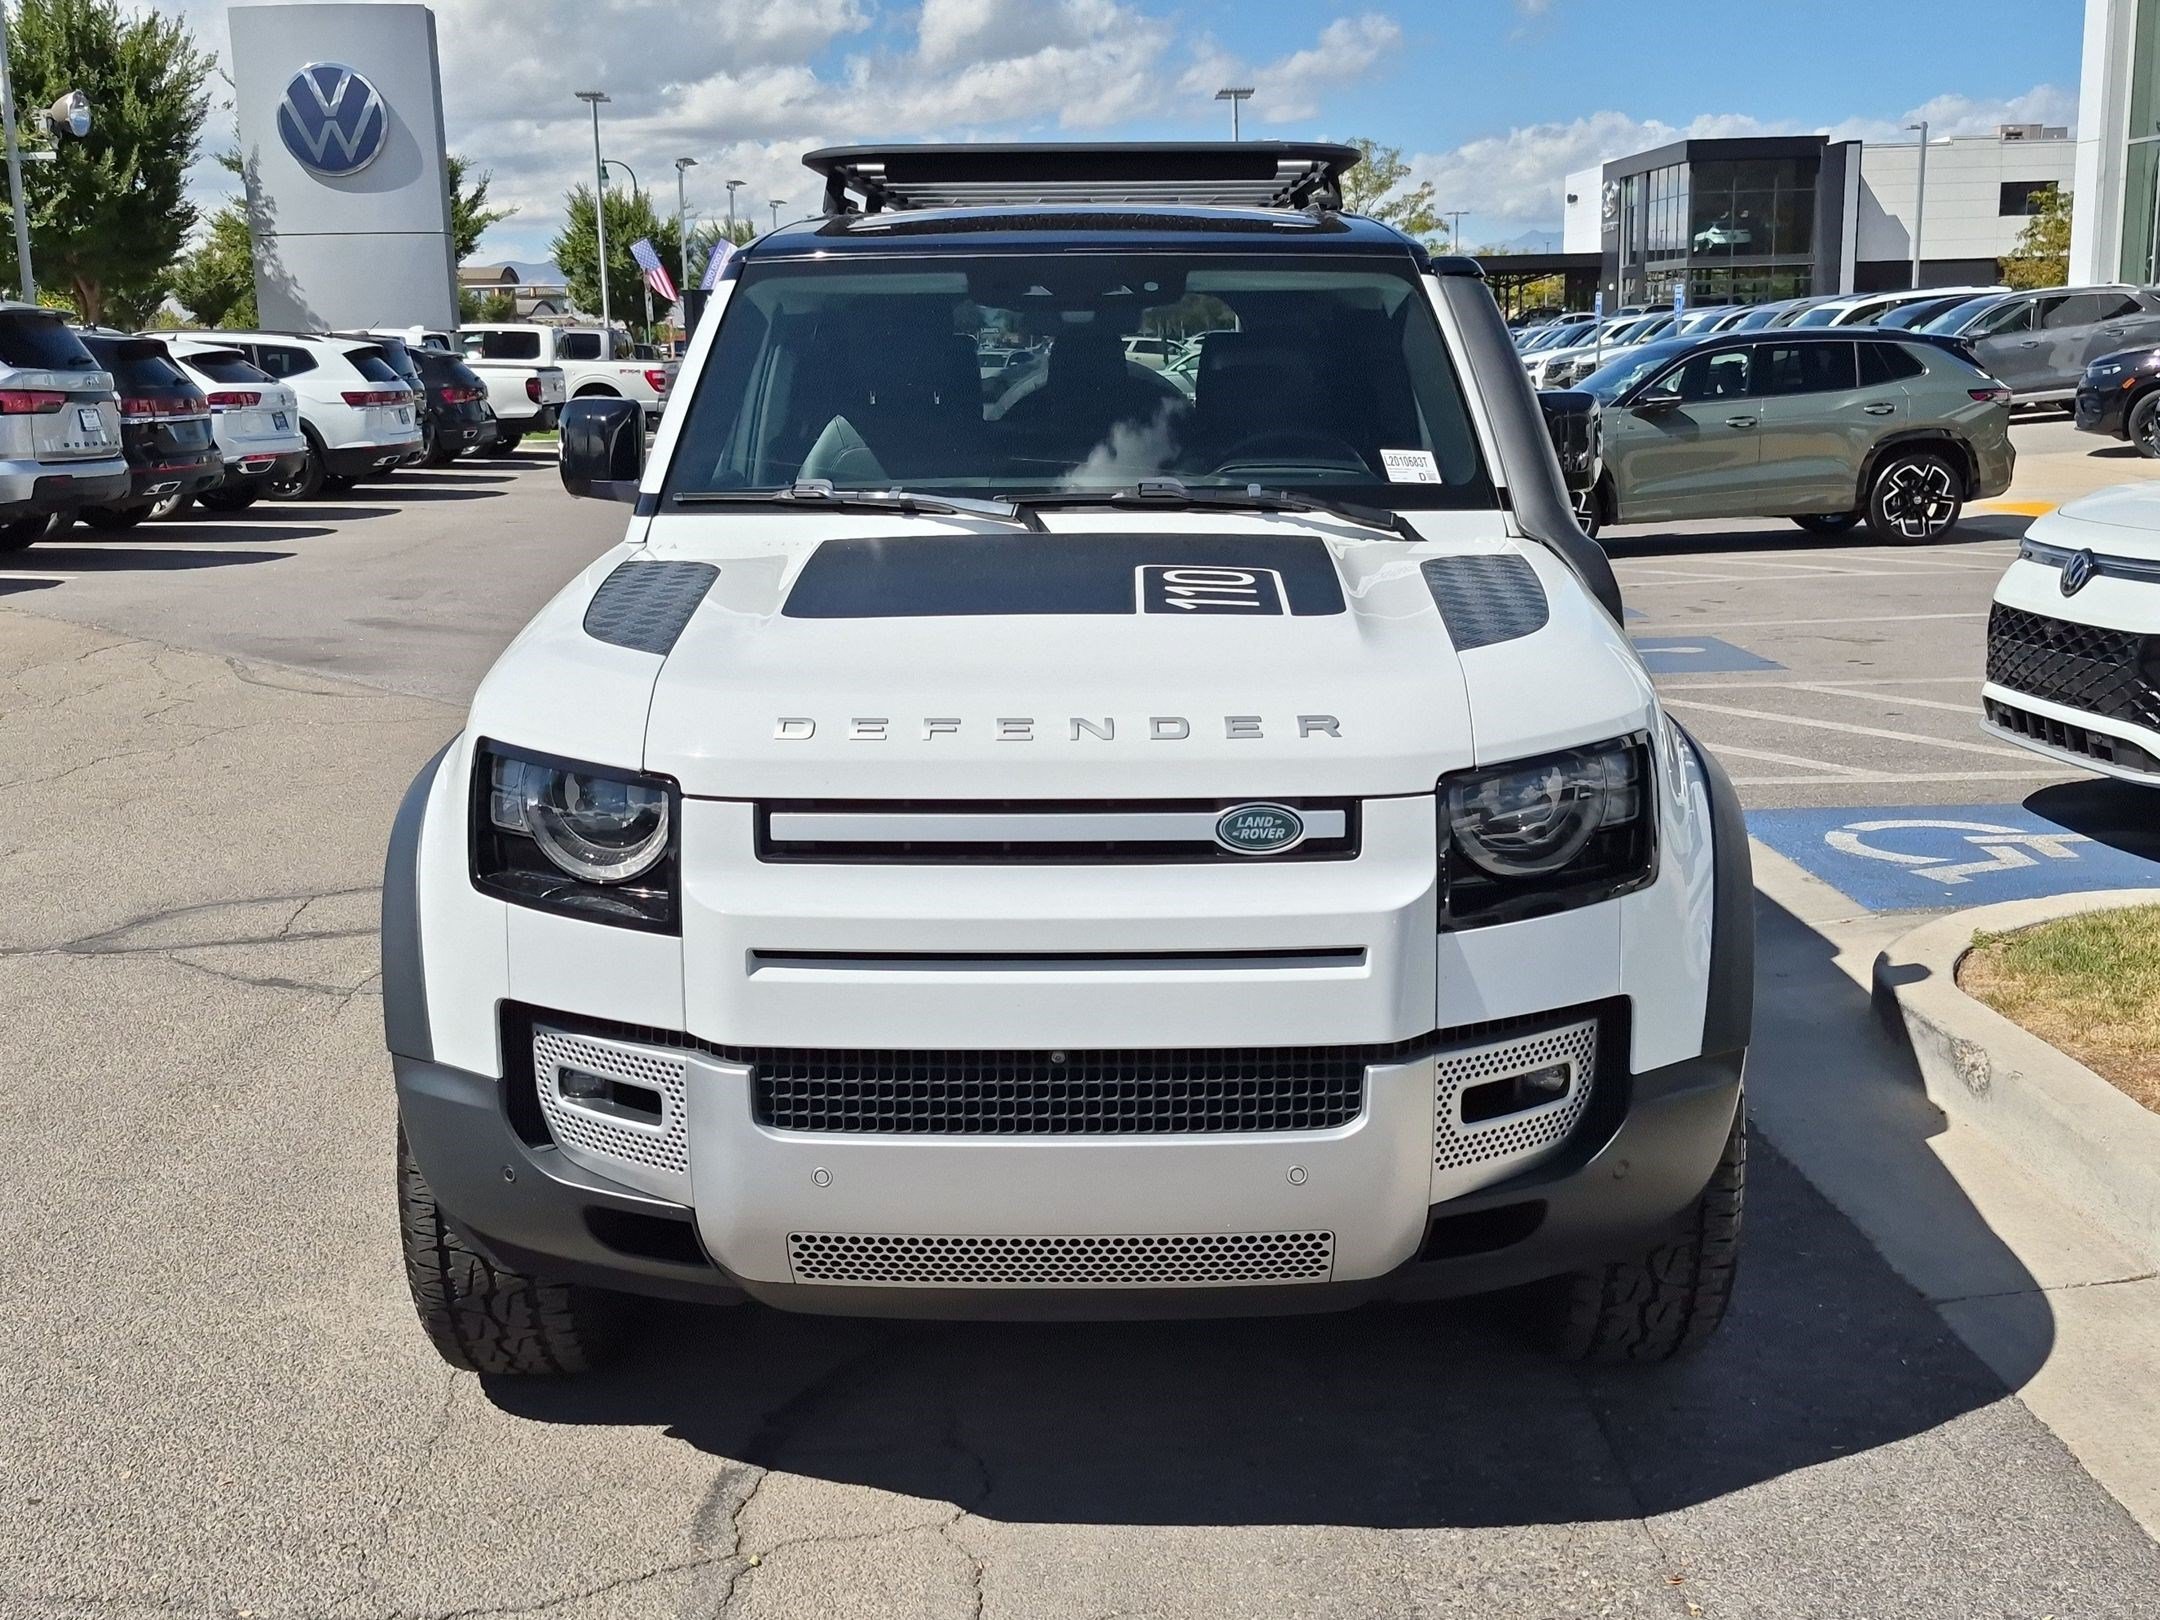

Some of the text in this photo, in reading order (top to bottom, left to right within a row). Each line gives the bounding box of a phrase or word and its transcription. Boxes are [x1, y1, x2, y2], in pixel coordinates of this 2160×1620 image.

[281, 67, 381, 164] VW
[1163, 569, 1260, 610] 110
[774, 714, 1342, 741] DEFENDER
